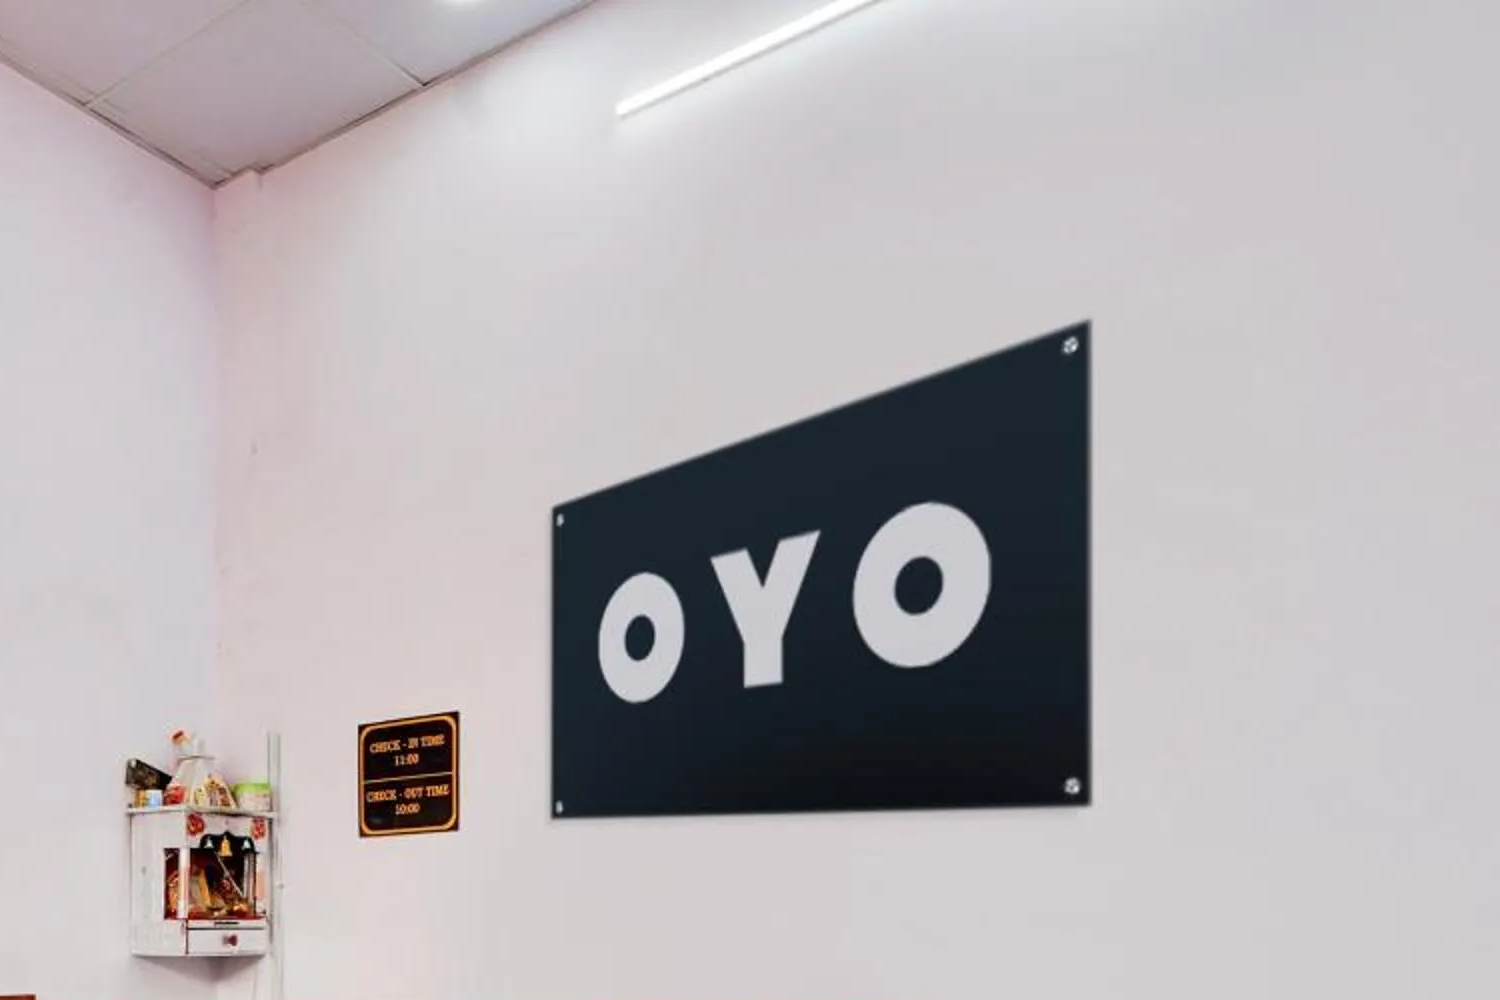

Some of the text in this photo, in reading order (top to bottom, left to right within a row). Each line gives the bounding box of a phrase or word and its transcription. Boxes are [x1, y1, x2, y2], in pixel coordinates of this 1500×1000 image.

[598, 501, 992, 703] OYO
[369, 739, 401, 753] CHECK
[408, 737, 419, 749] IN
[420, 734, 445, 747] TIME
[366, 789, 397, 803] CHECK
[403, 786, 424, 799] OUT
[425, 784, 450, 797] TIME
